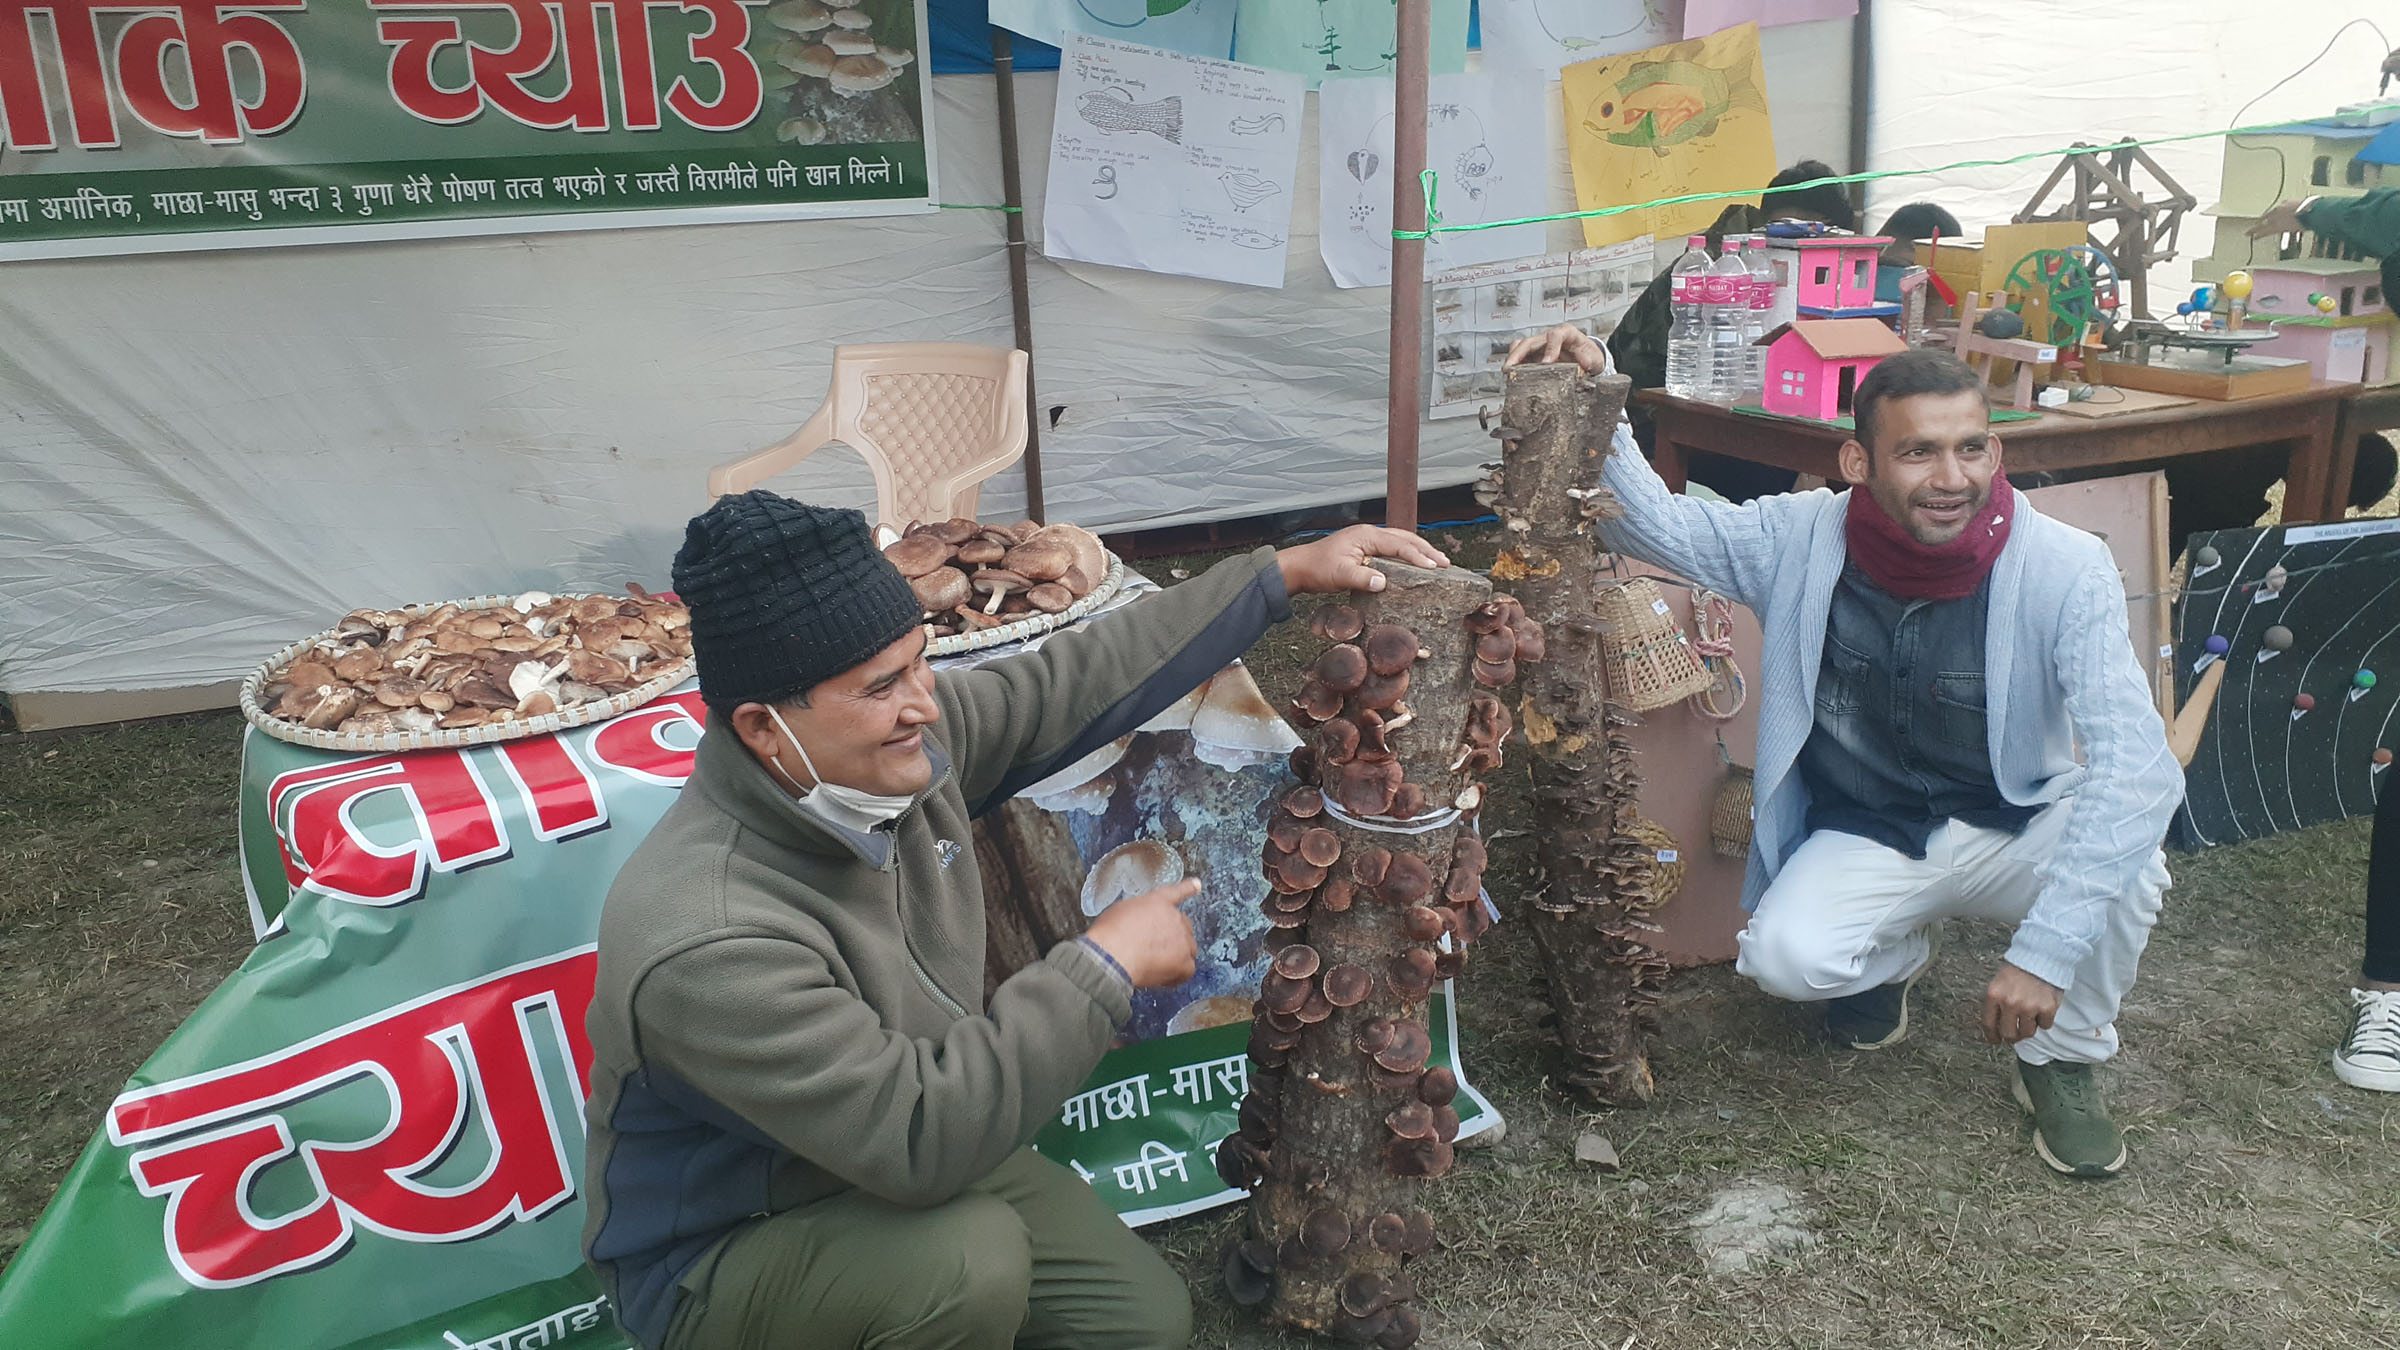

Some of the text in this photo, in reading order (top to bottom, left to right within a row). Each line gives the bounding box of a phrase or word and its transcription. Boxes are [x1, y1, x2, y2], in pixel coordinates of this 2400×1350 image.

[152, 187, 262, 220] माछा-मासु
[269, 185, 320, 213] भन्दा
[330, 187, 343, 211] ३
[353, 183, 393, 216] गुणा
[402, 173, 433, 205] धेरै
[442, 173, 496, 205] पोषण
[504, 176, 543, 200] तत्व
[553, 168, 605, 201] भएको
[615, 173, 627, 195] र
[636, 164, 679, 194] जस्तै
[687, 162, 758, 191] विरामीले
[766, 160, 798, 188] पनि
[805, 163, 841, 187] खान
[848, 156, 891, 185] मिल्ने
[1113, 1140, 1189, 1195] पनि
